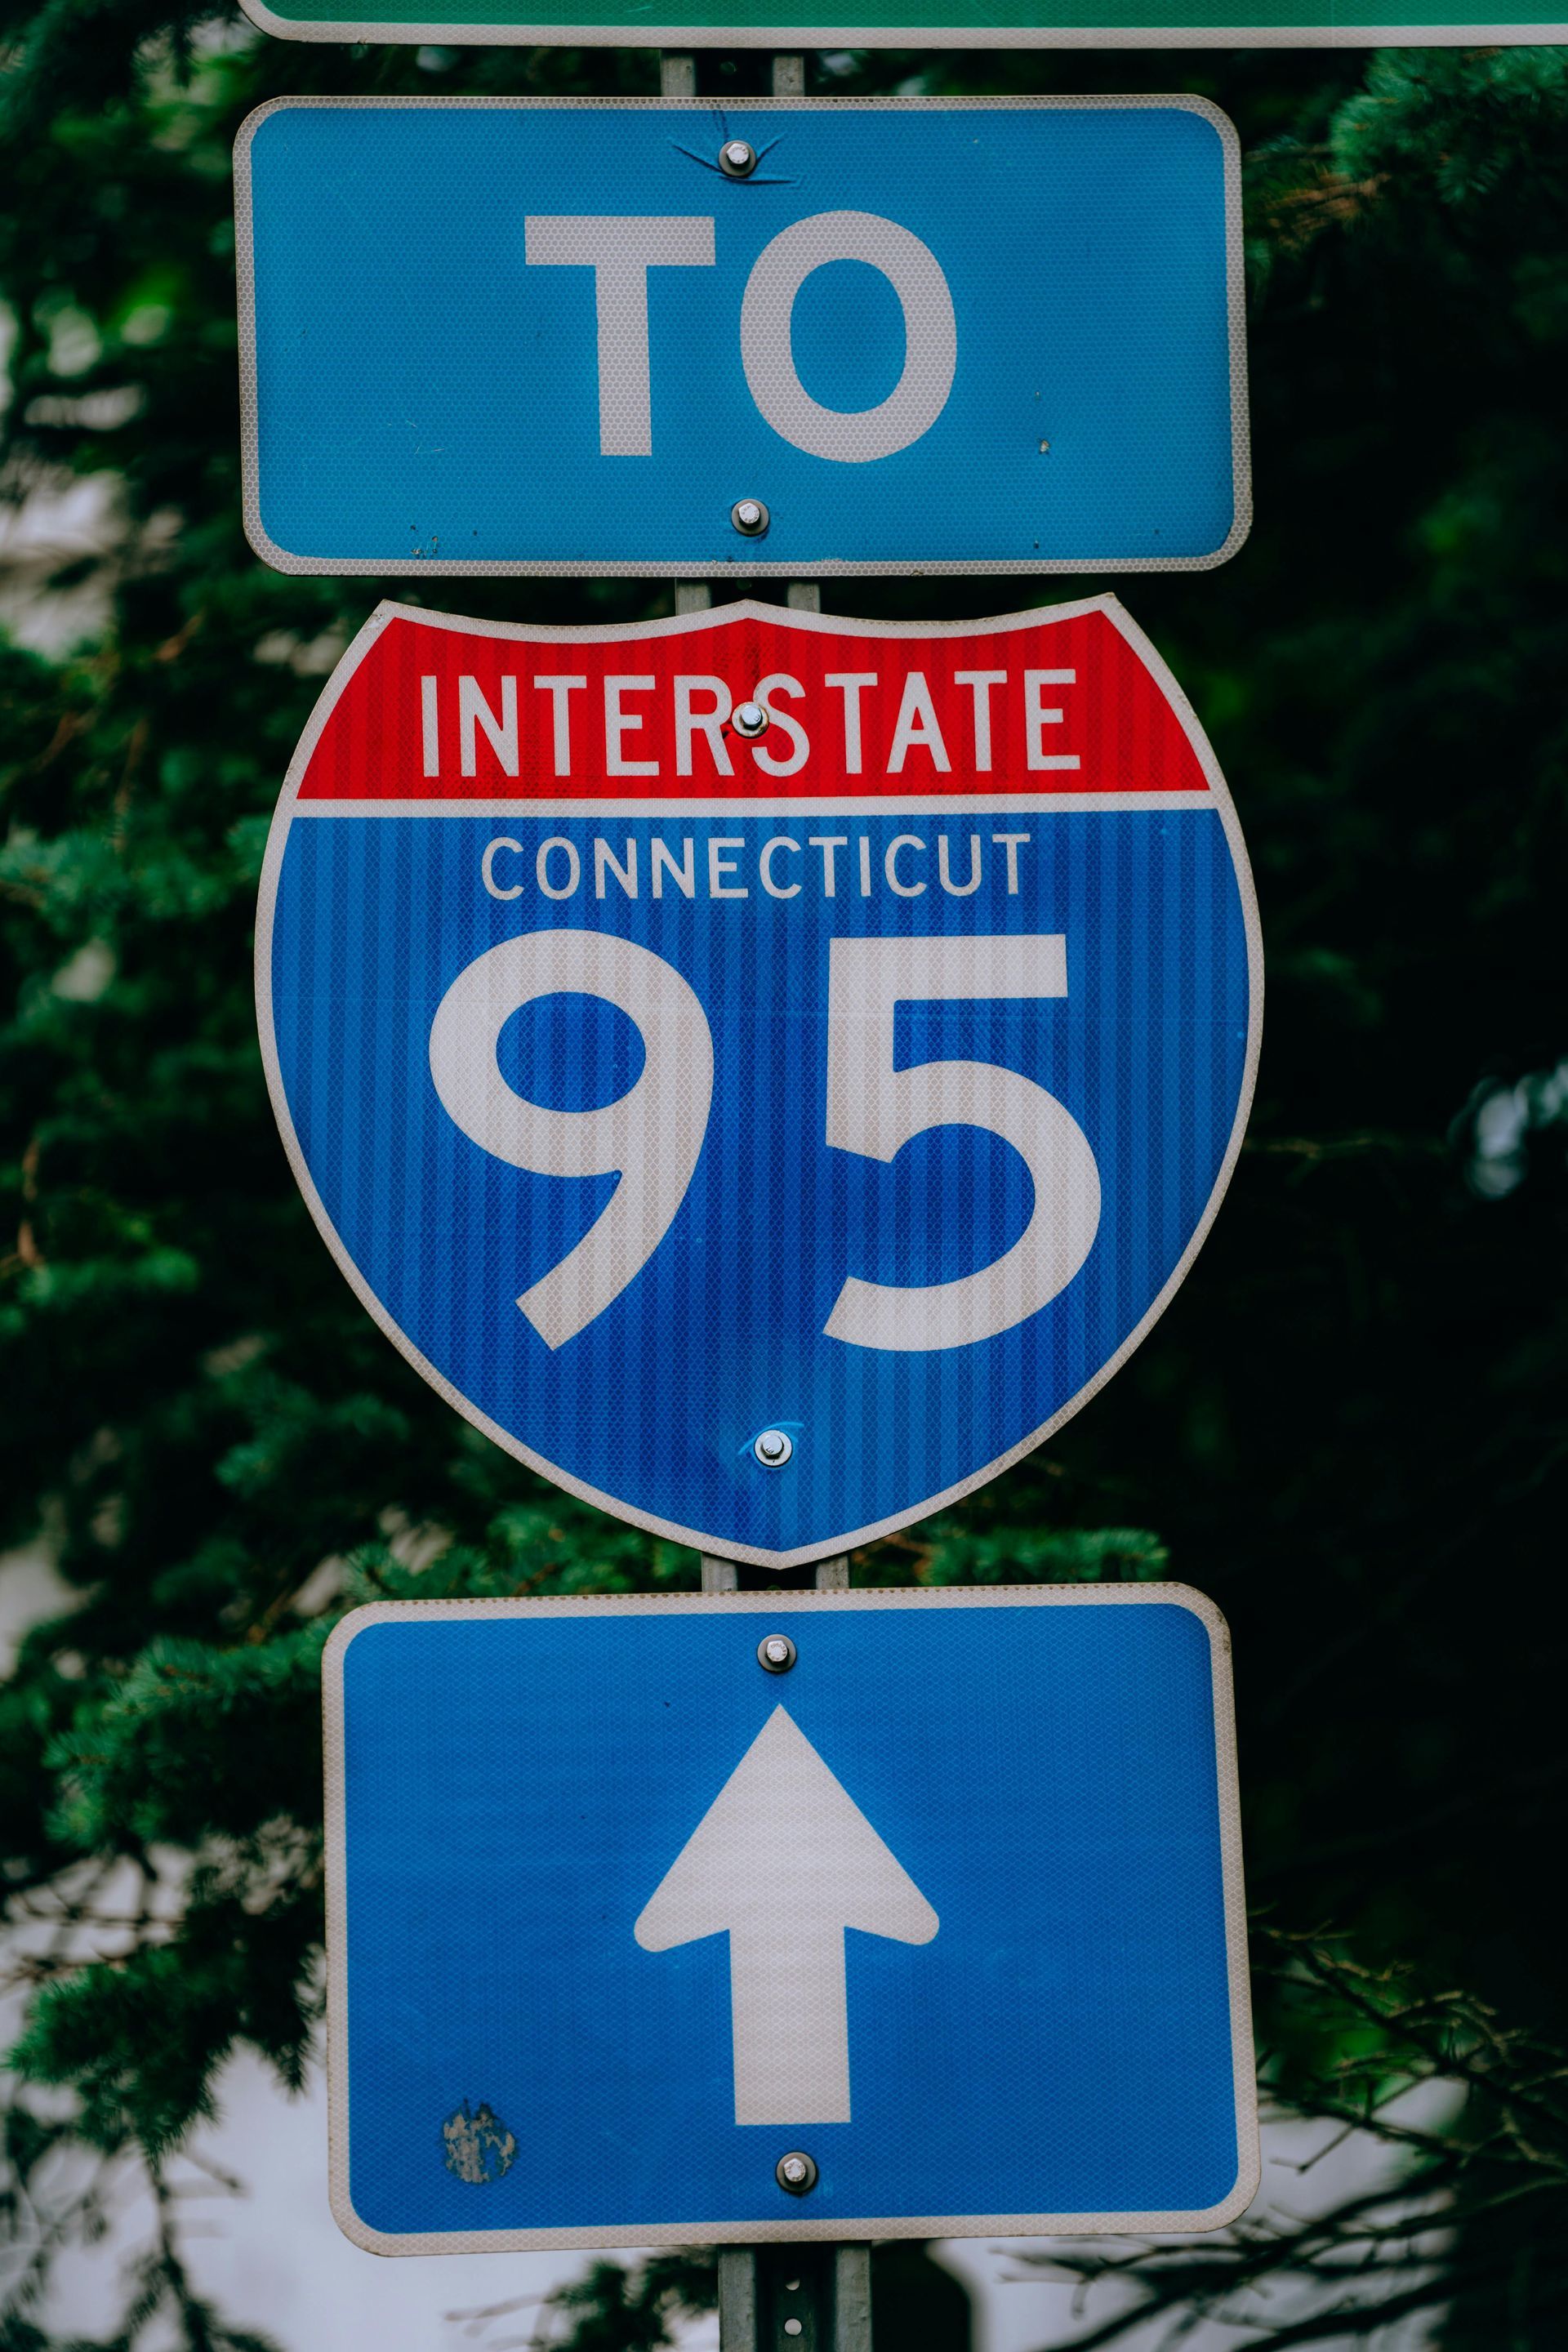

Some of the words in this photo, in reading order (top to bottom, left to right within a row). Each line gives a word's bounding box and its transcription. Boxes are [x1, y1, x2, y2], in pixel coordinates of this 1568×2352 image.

[524, 211, 956, 462] TO
[421, 669, 1080, 777] INTERSTATE
[482, 833, 1029, 900] CONNECTICUT
[430, 929, 1101, 1351] 95
